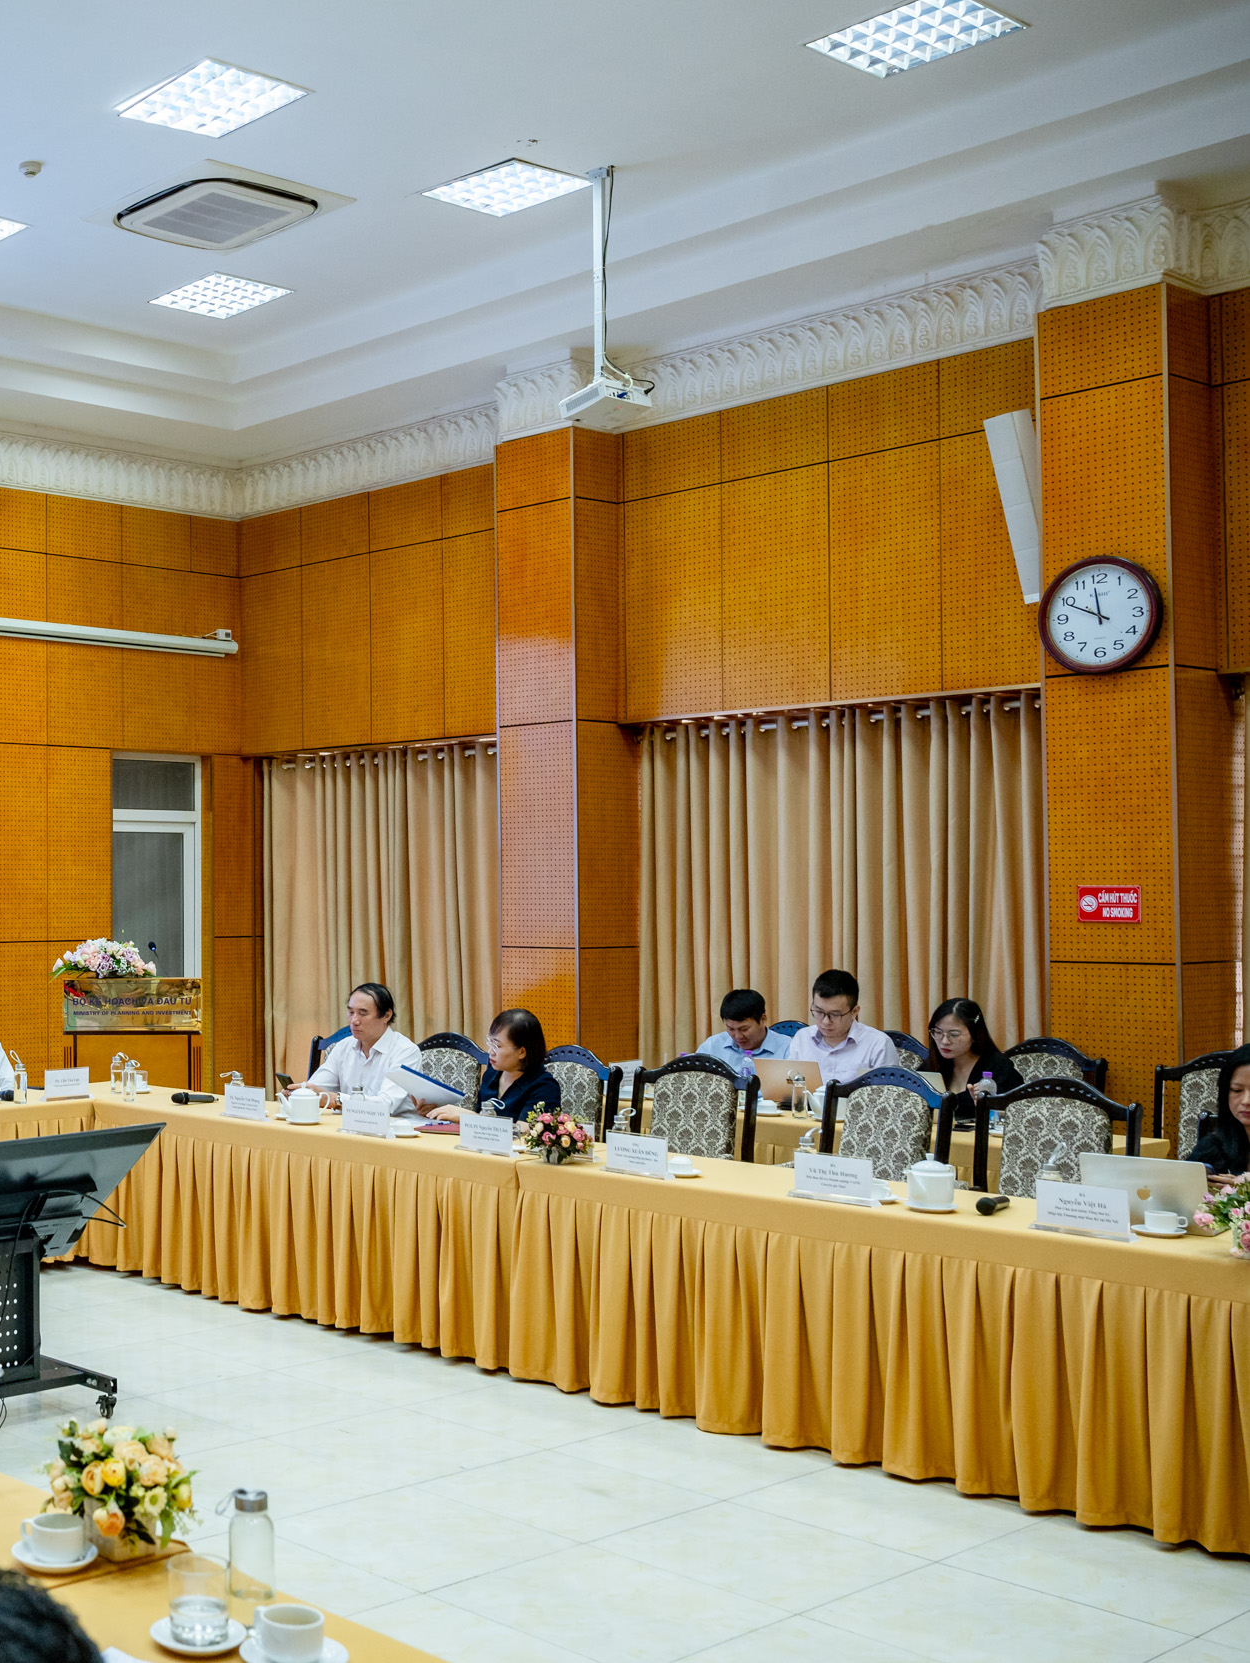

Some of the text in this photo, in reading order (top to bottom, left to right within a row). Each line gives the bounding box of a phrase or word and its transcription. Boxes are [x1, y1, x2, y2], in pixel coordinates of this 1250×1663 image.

[1092, 573, 1108, 584] 12
[1117, 576, 1121, 585] 1
[1076, 580, 1085, 590] 11
[1127, 589, 1138, 599] 2
[1062, 597, 1076, 606] 10
[1132, 606, 1144, 617] 3
[1057, 614, 1069, 625] 9
[1125, 625, 1138, 635] 4
[1063, 631, 1075, 641] 8
[1078, 642, 1087, 652] 7
[1113, 640, 1124, 650] 5
[1094, 647, 1106, 658] 6
[1102, 907, 1133, 918] NO SMOKING
[1058, 1197, 1082, 1206] Nguyễn
